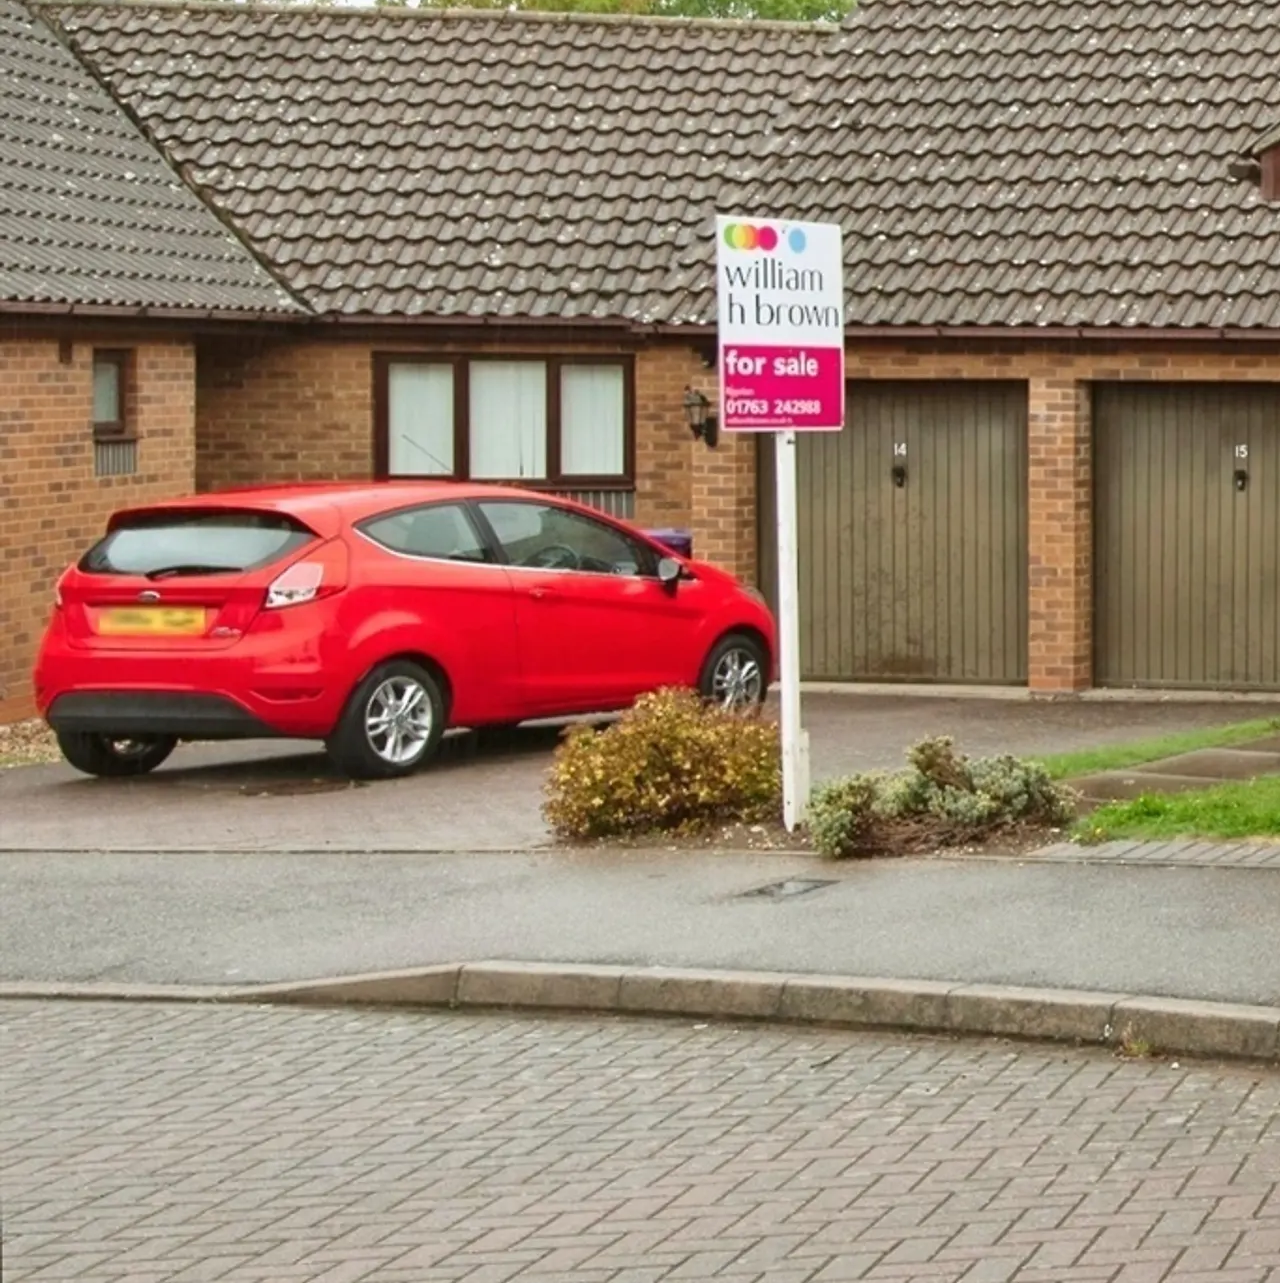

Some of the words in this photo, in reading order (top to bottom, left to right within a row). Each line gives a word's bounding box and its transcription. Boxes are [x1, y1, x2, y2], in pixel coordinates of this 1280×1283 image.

[725, 257, 824, 291] william
[728, 293, 745, 324] h
[755, 294, 839, 328] brown
[725, 349, 767, 376] for
[773, 351, 819, 377] sale
[726, 399, 768, 415] 01763
[894, 442, 907, 456] 14
[1235, 444, 1248, 459] 15
